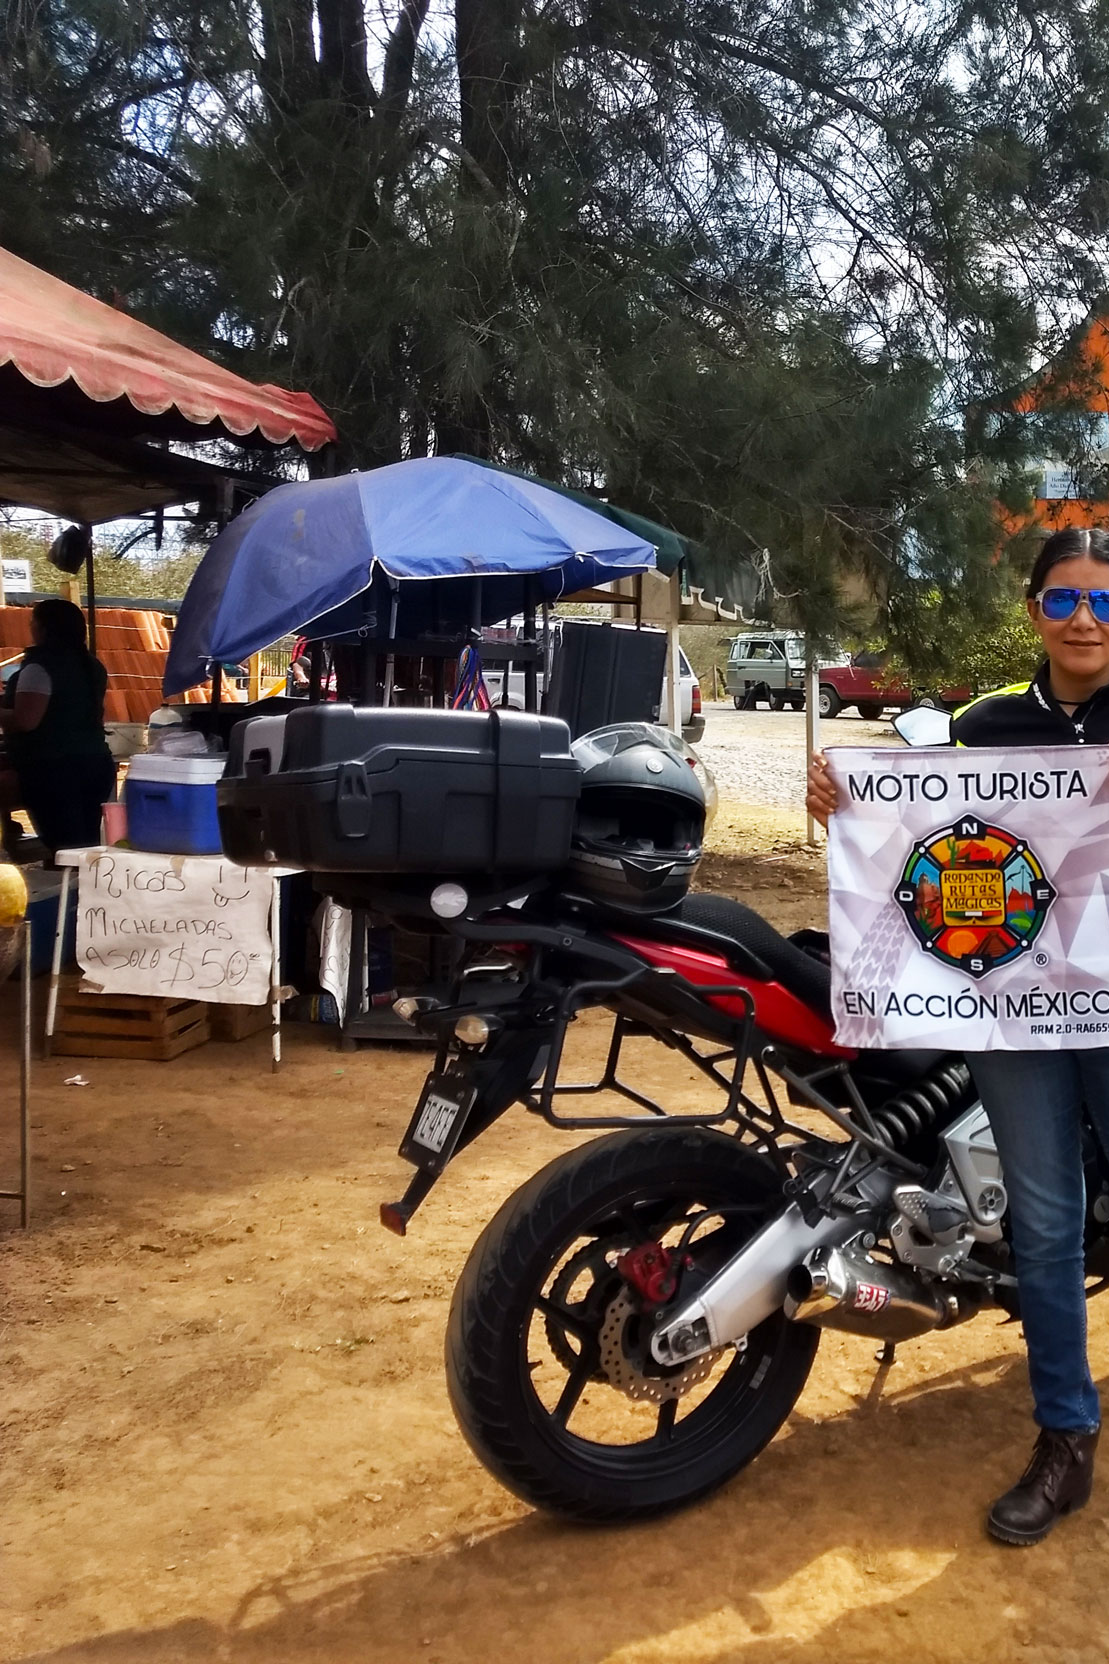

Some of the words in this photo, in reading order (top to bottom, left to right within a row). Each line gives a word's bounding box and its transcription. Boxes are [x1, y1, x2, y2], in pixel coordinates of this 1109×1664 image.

[848, 773, 948, 801] MOTO
[957, 770, 1089, 801] TURISTA
[843, 991, 875, 1017] EN
[884, 987, 998, 1019] ACCIÓN
[1031, 1024, 1054, 1035] RRM
